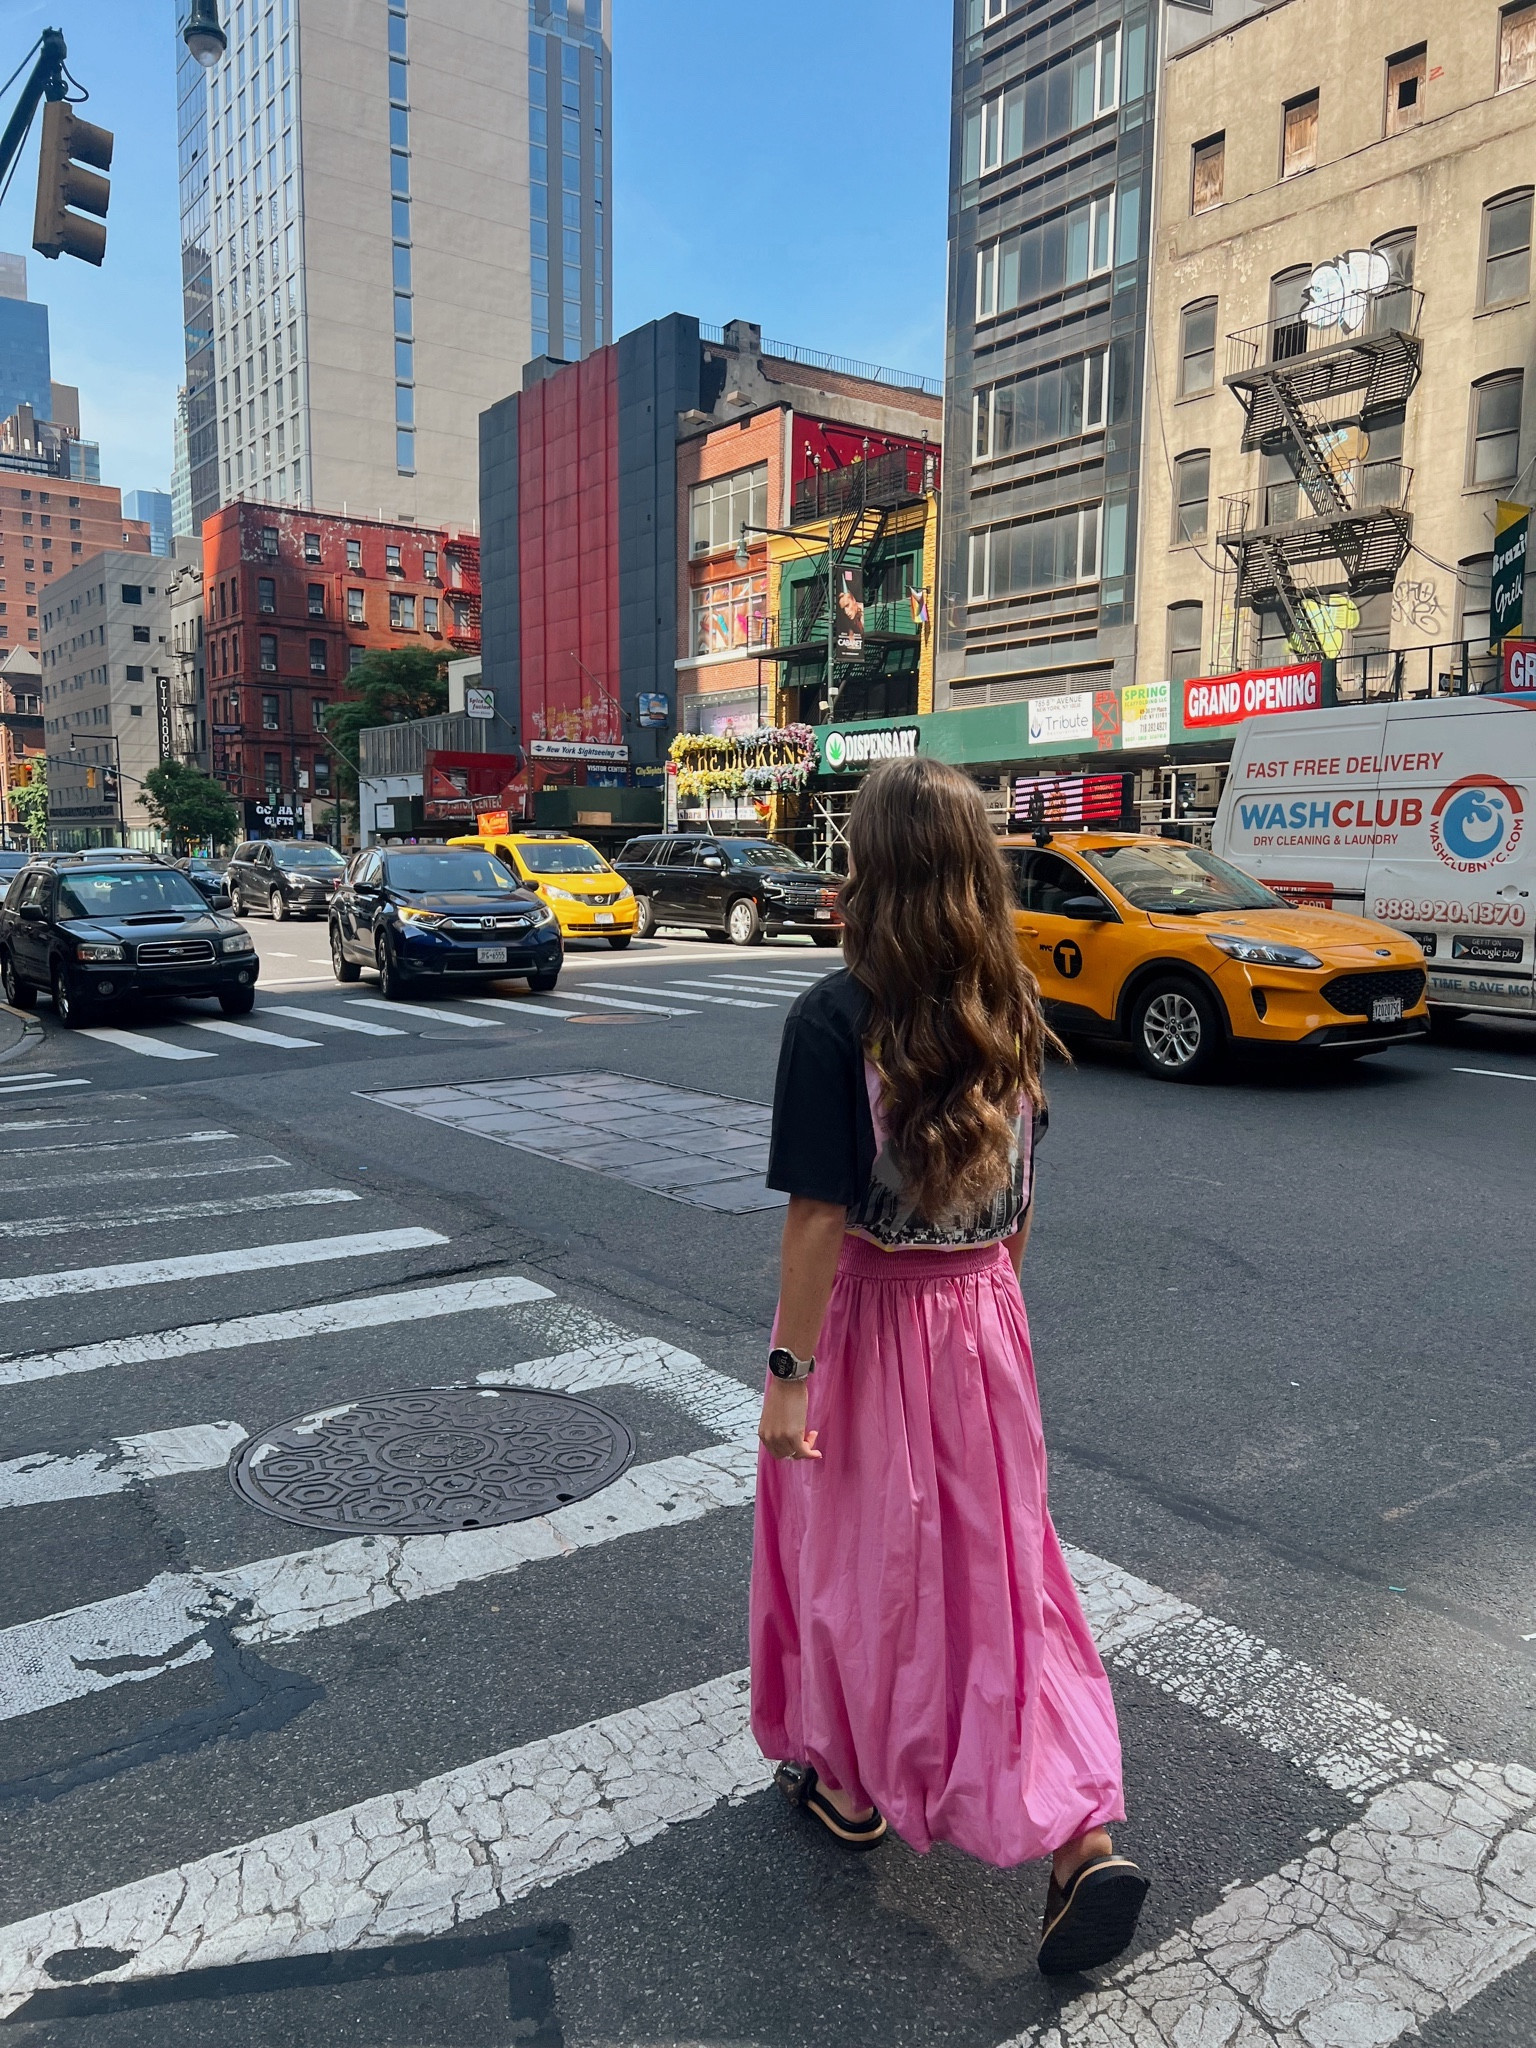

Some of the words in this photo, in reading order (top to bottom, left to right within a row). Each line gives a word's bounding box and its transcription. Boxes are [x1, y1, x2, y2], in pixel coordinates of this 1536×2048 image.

[838, 639, 862, 647] CABARET
[160, 680, 168, 715] CITY
[1057, 695, 1082, 704] AVENUE
[1125, 686, 1167, 701] SPRING
[1189, 682, 1241, 717] GRAND
[1244, 671, 1316, 711] OPENING
[1045, 713, 1089, 730] Tribute
[546, 745, 560, 753] New
[562, 746, 576, 754] York
[578, 747, 616, 758] Sightseeing
[845, 729, 917, 761] DISPENSARY
[725, 743, 809, 771] DICKENS
[587, 765, 607, 773] VISITOR
[608, 765, 628, 773] CENTER
[1246, 760, 1289, 779] FAST
[1293, 757, 1341, 777] FREE
[1346, 752, 1444, 774] DELIVERY
[264, 816, 294, 826] GIFTS
[1240, 798, 1423, 830] WASHCLUB
[1253, 835, 1274, 846] DRY
[1276, 834, 1331, 846] CLEANING
[1333, 834, 1342, 846] &
[1344, 833, 1399, 846] LAUNDRY
[1429, 818, 1524, 873] WASHCLUBNYC.COM
[1374, 898, 1526, 927] 888.920.1370
[1039, 944, 1052, 952] NYC
[1472, 938, 1484, 946] GET
[1060, 947, 1076, 974] T
[1470, 946, 1502, 959] Google
[1502, 949, 1520, 960] play
[1468, 981, 1504, 994] SAVE
